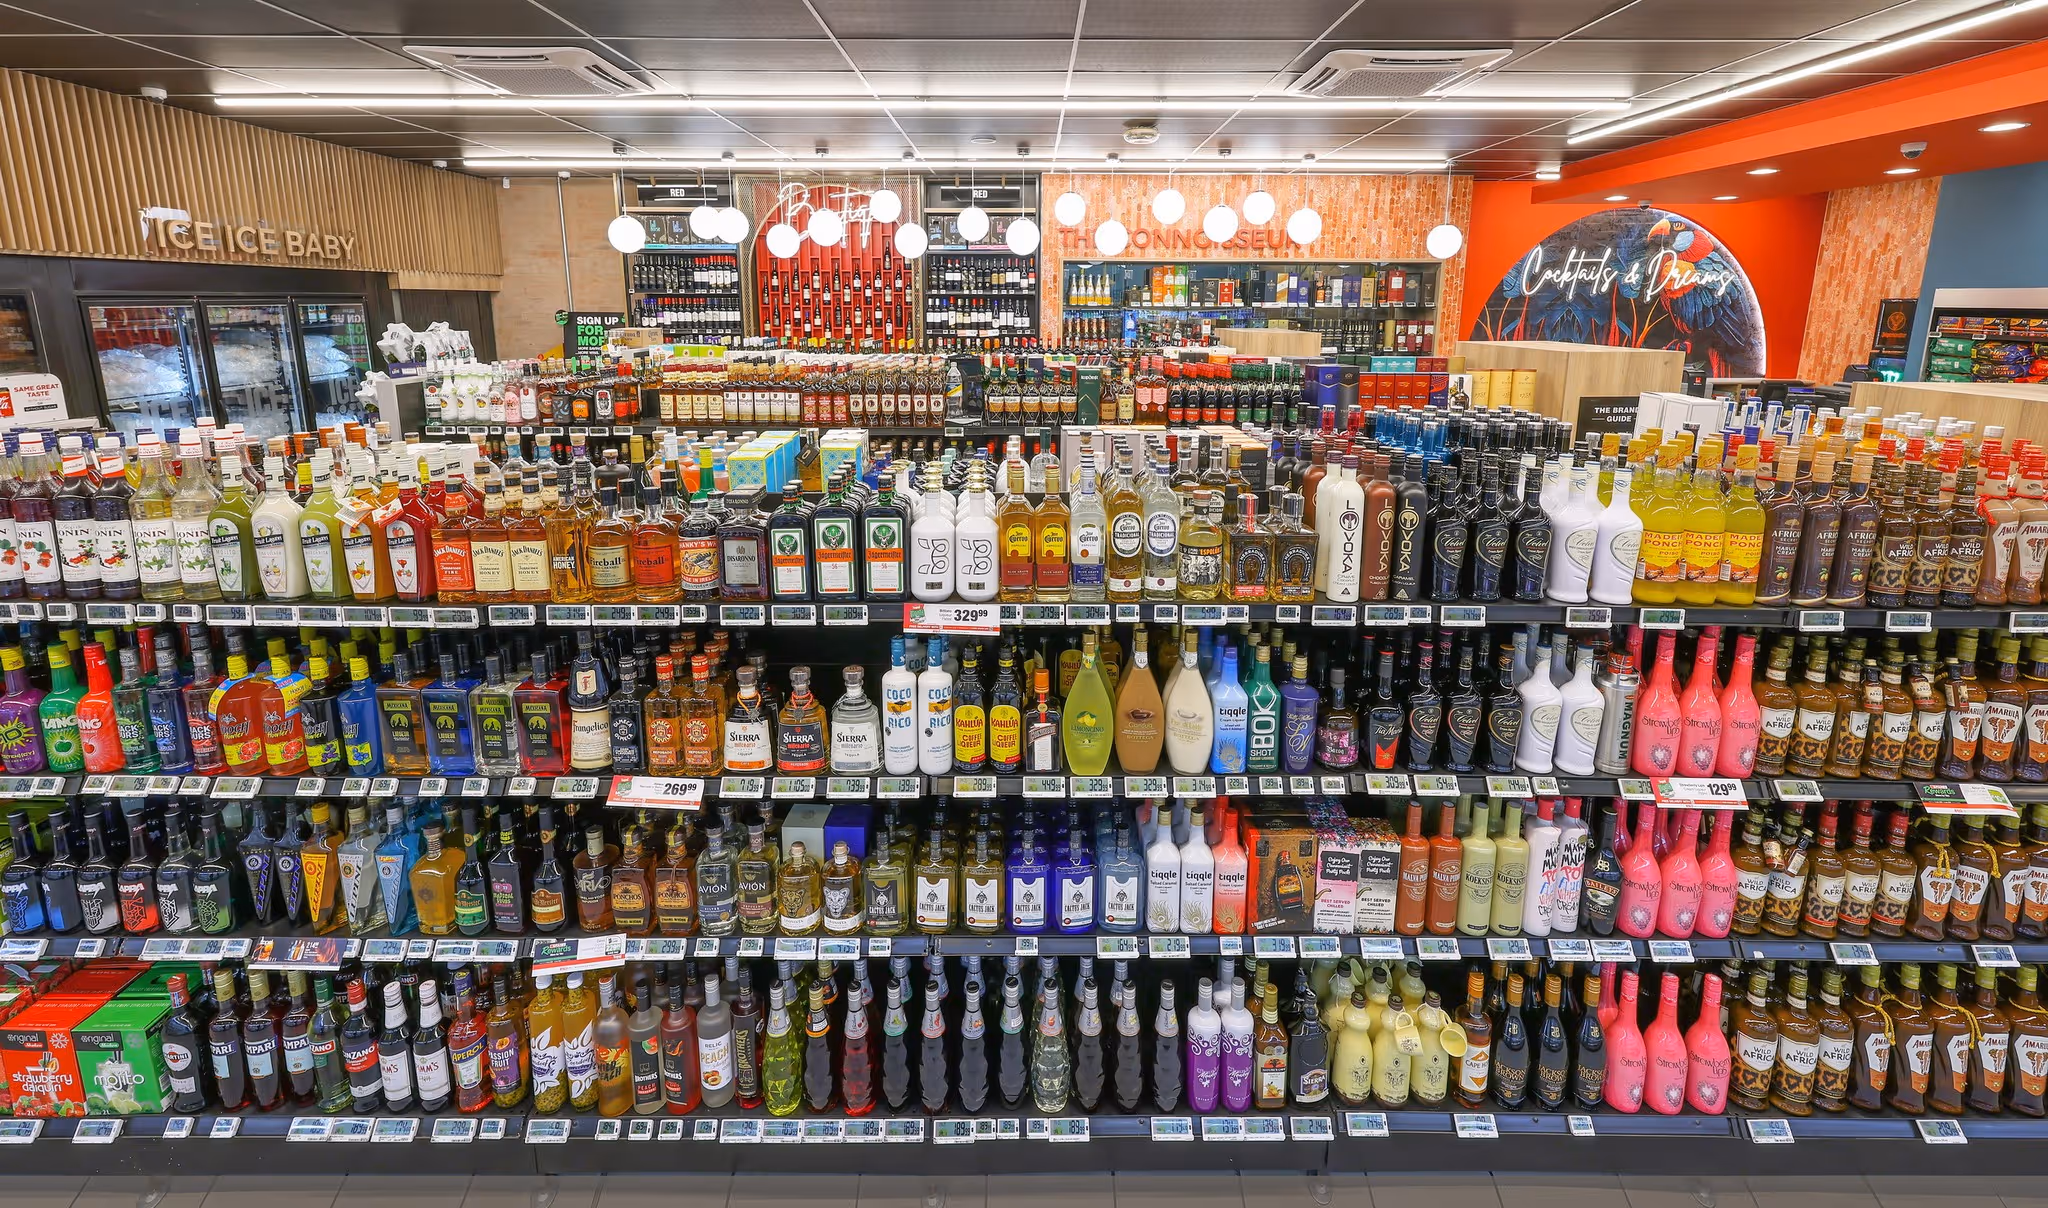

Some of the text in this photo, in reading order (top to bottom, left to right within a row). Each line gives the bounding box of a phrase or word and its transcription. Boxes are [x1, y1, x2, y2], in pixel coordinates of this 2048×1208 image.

[670, 189, 685, 197] RED
[973, 190, 988, 198] RED
[155, 218, 354, 260] ICE ICE BABY
[1521, 244, 1733, 304] Cocktails & Dreams
[576, 316, 619, 325] SIGN UP
[577, 326, 602, 336] FOR
[14, 383, 59, 393] SAME GREAT
[1606, 415, 1632, 423] GUIDE
[1080, 534, 1098, 542] Cuervo
[434, 546, 445, 556] JACK
[473, 546, 504, 556] JACK DANIEL'S
[511, 546, 543, 556] JACK DANIEL'S
[886, 689, 911, 699] COCO
[928, 689, 951, 699] COCO
[1986, 705, 2020, 720] AMARULA
[573, 720, 609, 733] Frangelico
[889, 718, 910, 728] RICO
[930, 718, 951, 728] RICO
[1619, 702, 1633, 759] MAGNUM
[730, 732, 760, 742] SIERRA
[783, 733, 814, 743] SIERRA
[837, 733, 867, 743] SIERRA
[962, 734, 982, 742] COFFEE
[1923, 786, 1955, 796] Rewards
[349, 863, 362, 918] LUPINI
[1584, 879, 1618, 896] BAILEYS
[935, 904, 946, 912] JACK
[984, 904, 994, 912] JACK
[542, 947, 572, 956] Rewards
[705, 1041, 722, 1049] RELIC
[737, 1030, 748, 1069] BROTHERS
[1754, 1046, 1771, 1054] WILD
[1834, 1046, 1849, 1054] WILD
[452, 1043, 483, 1062] APEROL
[701, 1044, 728, 1064] PEACH
[1796, 1050, 1814, 1058] WILD
[491, 1058, 509, 1067] FRUIT
[1495, 1060, 1525, 1076] JACKSON
[1497, 1066, 1524, 1080] BROWN
[12, 1073, 72, 1085] strawberry
[94, 1073, 145, 1090] mojito
[1303, 1075, 1326, 1085] SIERRA
[22, 1082, 62, 1094] daiquiri
